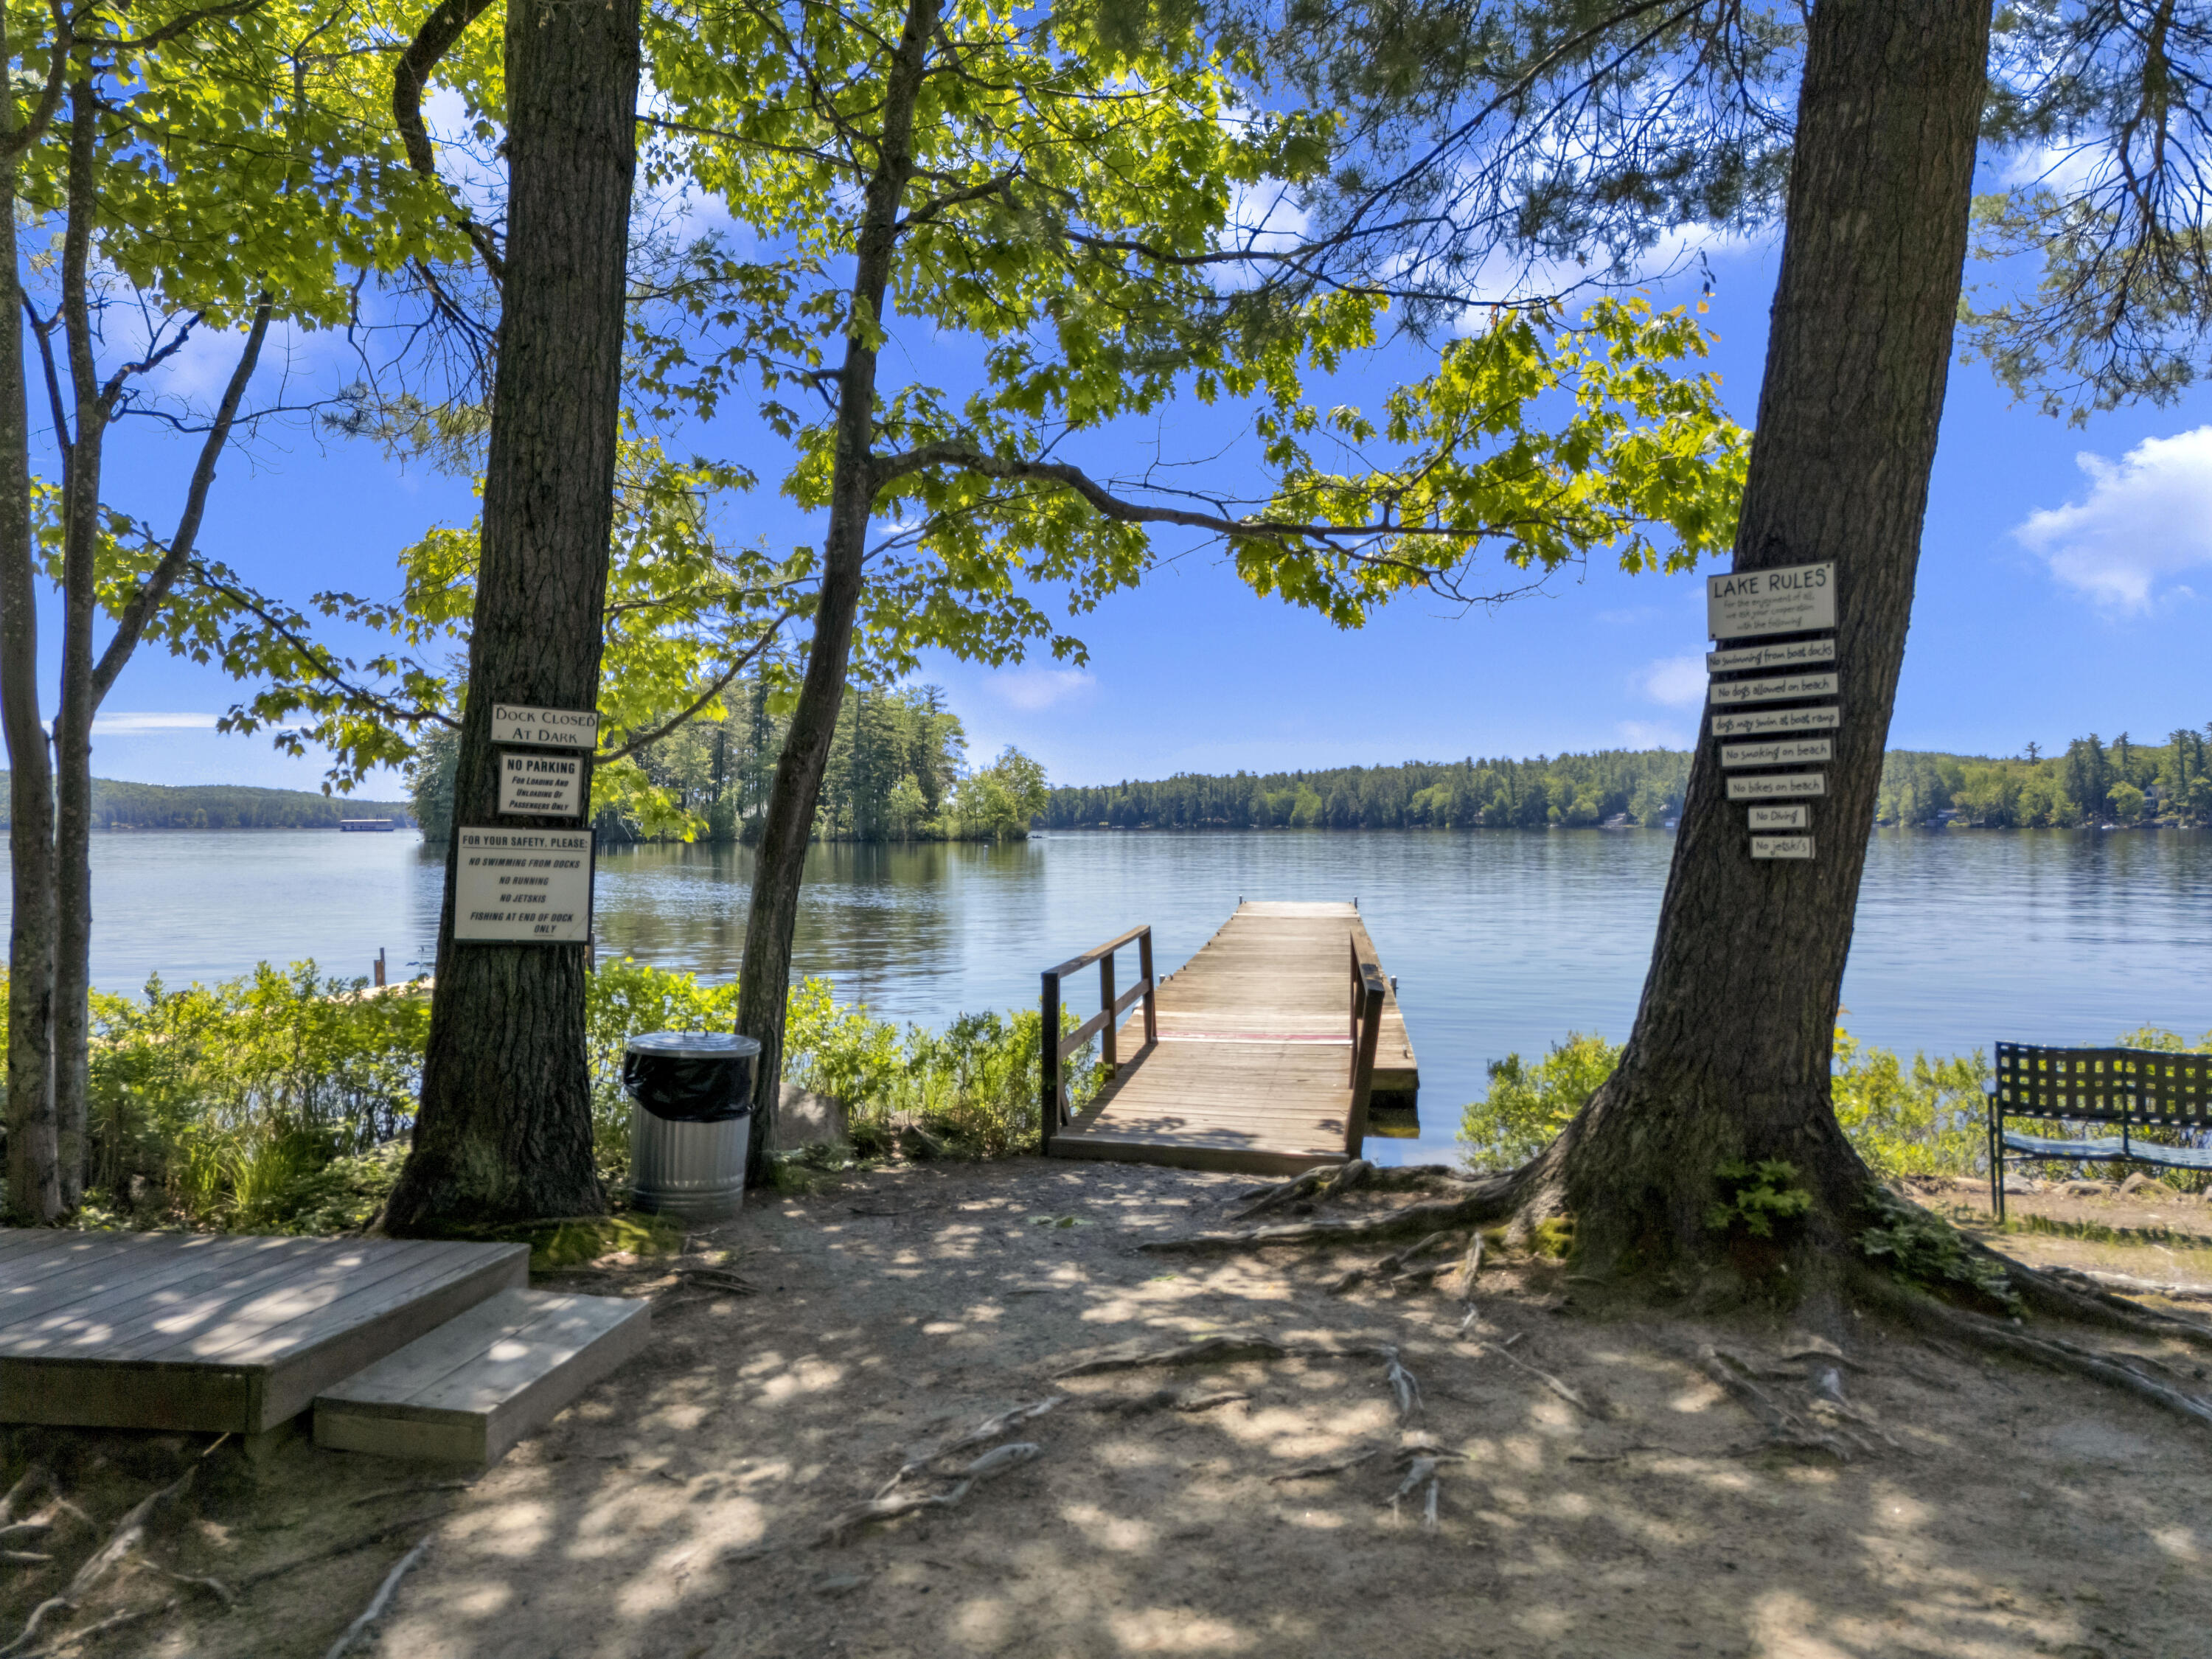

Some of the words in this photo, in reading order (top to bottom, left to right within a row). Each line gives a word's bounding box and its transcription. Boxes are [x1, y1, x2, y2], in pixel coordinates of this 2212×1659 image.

[1714, 577, 1759, 598] LAKE
[1770, 568, 1826, 591] RULES
[1709, 656, 1720, 665] No
[1722, 651, 1762, 666] swimming
[1764, 649, 1785, 663] from
[1787, 647, 1806, 659] boat
[1808, 644, 1832, 655] docks
[1719, 689, 1730, 698] No
[1733, 684, 1750, 700] dogs
[1753, 680, 1786, 695] allowed
[1801, 678, 1829, 690] beach
[1717, 717, 1734, 732] dogs
[1736, 720, 1753, 731] may
[1756, 717, 1777, 728] swim
[1780, 715, 1788, 726] at
[1790, 714, 1809, 725] boat
[1812, 714, 1834, 727] ramp
[1726, 751, 1739, 759] No
[1797, 743, 1826, 756] beach
[507, 759, 522, 771] NO
[526, 760, 575, 774] PARKING
[1733, 784, 1745, 793] No
[1749, 782, 1773, 793] bikes
[1790, 779, 1820, 791] beach
[1756, 812, 1768, 821] No
[1770, 810, 1798, 824] Diving
[462, 835, 480, 845] FOR
[484, 836, 507, 846] YOUR
[511, 837, 548, 848] SAFETY,
[1756, 841, 1769, 849] No
[469, 858, 480, 866] NO
[482, 858, 526, 867] SWIMMING
[528, 859, 551, 868] FROM
[554, 860, 580, 869] DOCKS
[499, 876, 509, 885] NO
[512, 877, 549, 886] RUNNING
[500, 894, 512, 902] NO
[513, 894, 546, 903] JETSKIS
[470, 912, 503, 921] FISHING
[507, 913, 516, 921] AT
[519, 913, 535, 922] END
[538, 914, 549, 922] OF
[551, 914, 574, 922] DOCK
[534, 925, 557, 933] ONLY
